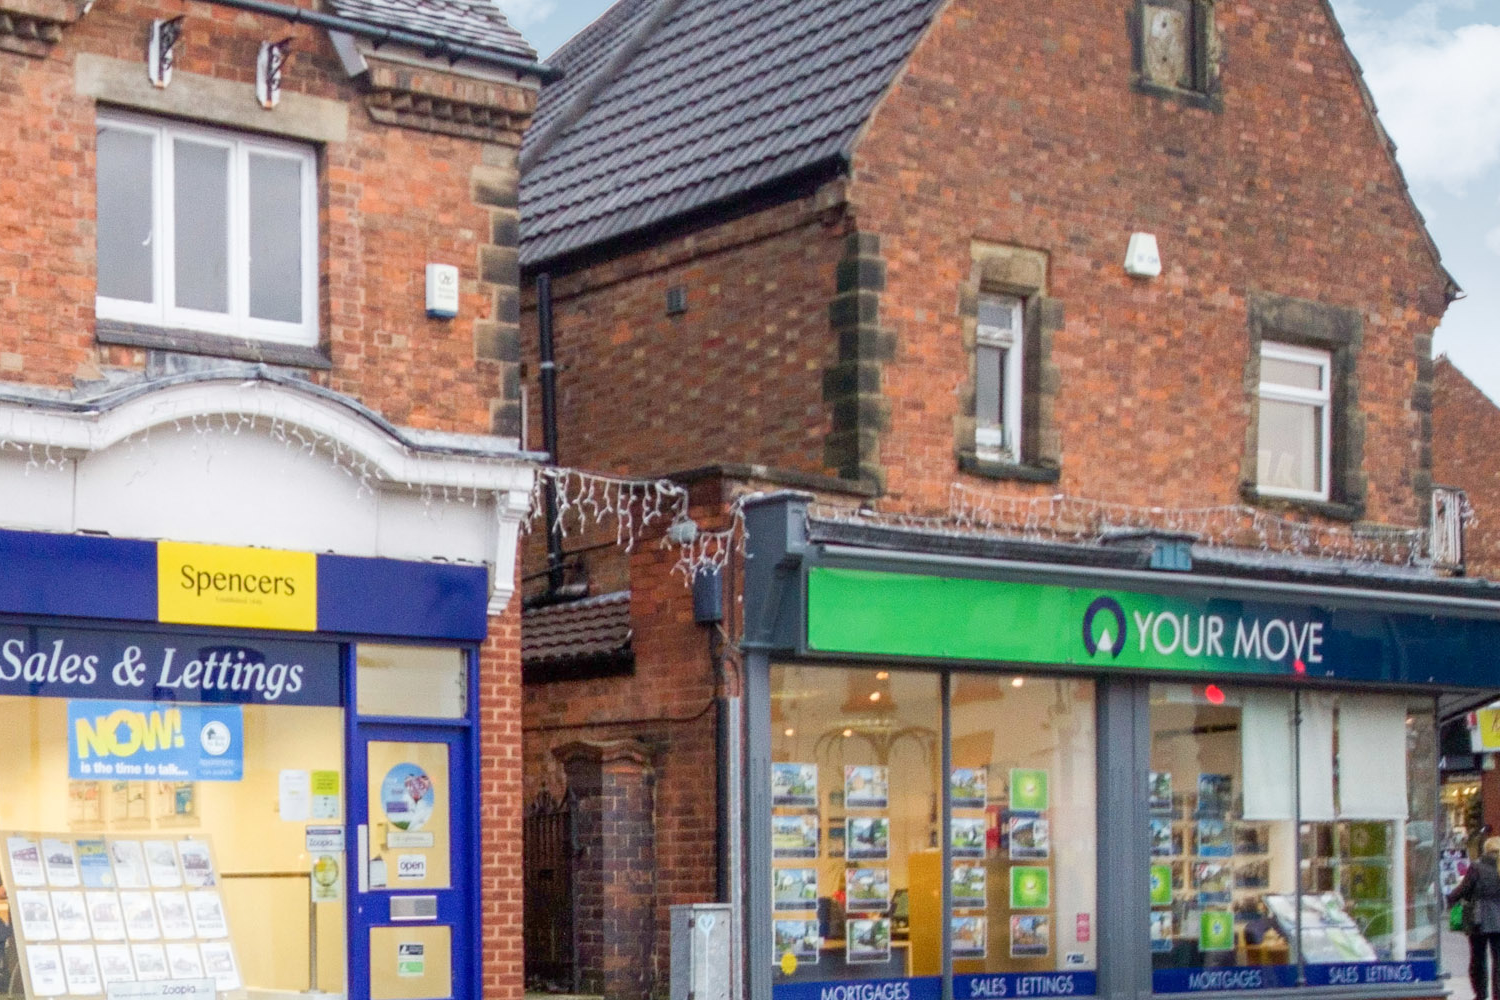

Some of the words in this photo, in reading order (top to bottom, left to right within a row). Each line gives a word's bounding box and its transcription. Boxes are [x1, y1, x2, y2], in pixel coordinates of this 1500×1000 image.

[181, 564, 295, 597] Spencers
[1133, 610, 1224, 657] YOUR
[1232, 617, 1324, 663] MOVE
[112, 645, 146, 687] &
[156, 647, 304, 700] Lettings
[75, 708, 185, 759] NOW!
[80, 761, 91, 774] is
[93, 761, 113, 774] the
[115, 762, 142, 775] time
[144, 763, 156, 775] to
[400, 861, 424, 872] open
[1188, 969, 1262, 990] MORTGAGES
[1328, 965, 1359, 985] SALES
[1365, 964, 1412, 982] LETTINGS
[970, 977, 1006, 998] SALES
[1015, 975, 1074, 996] LETTINGS
